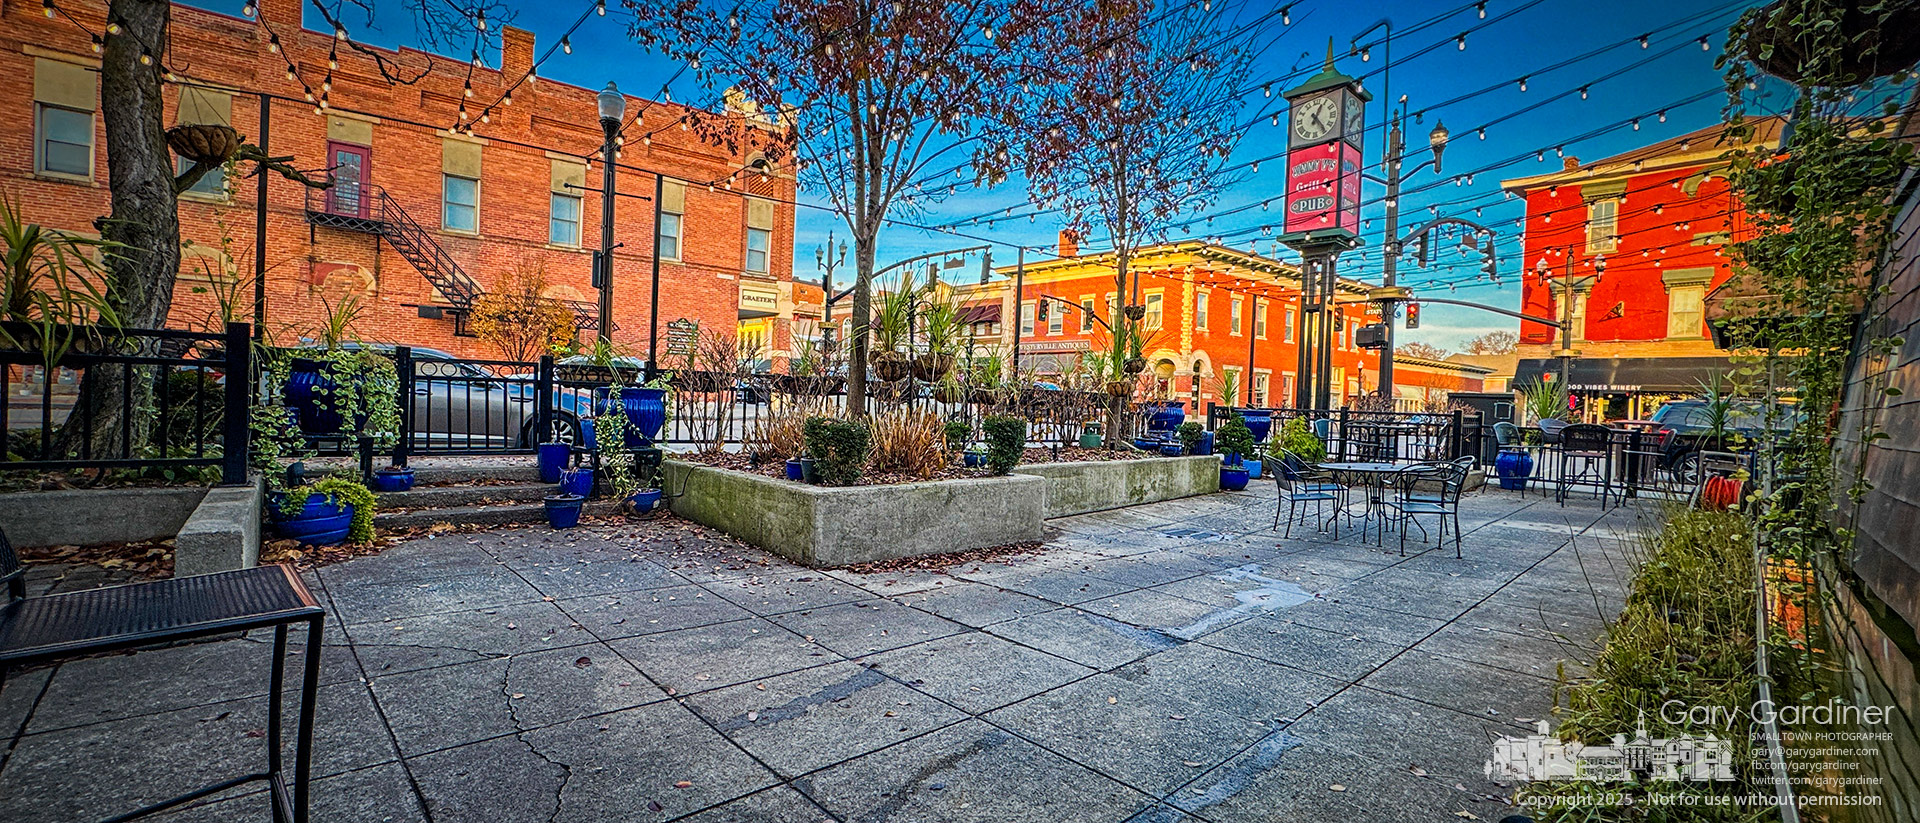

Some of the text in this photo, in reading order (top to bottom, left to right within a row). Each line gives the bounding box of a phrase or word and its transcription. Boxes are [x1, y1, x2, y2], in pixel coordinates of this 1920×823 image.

[1296, 180, 1320, 192] Grill
[1300, 198, 1325, 211] PUB
[1058, 341, 1089, 350] ANTIQUES
